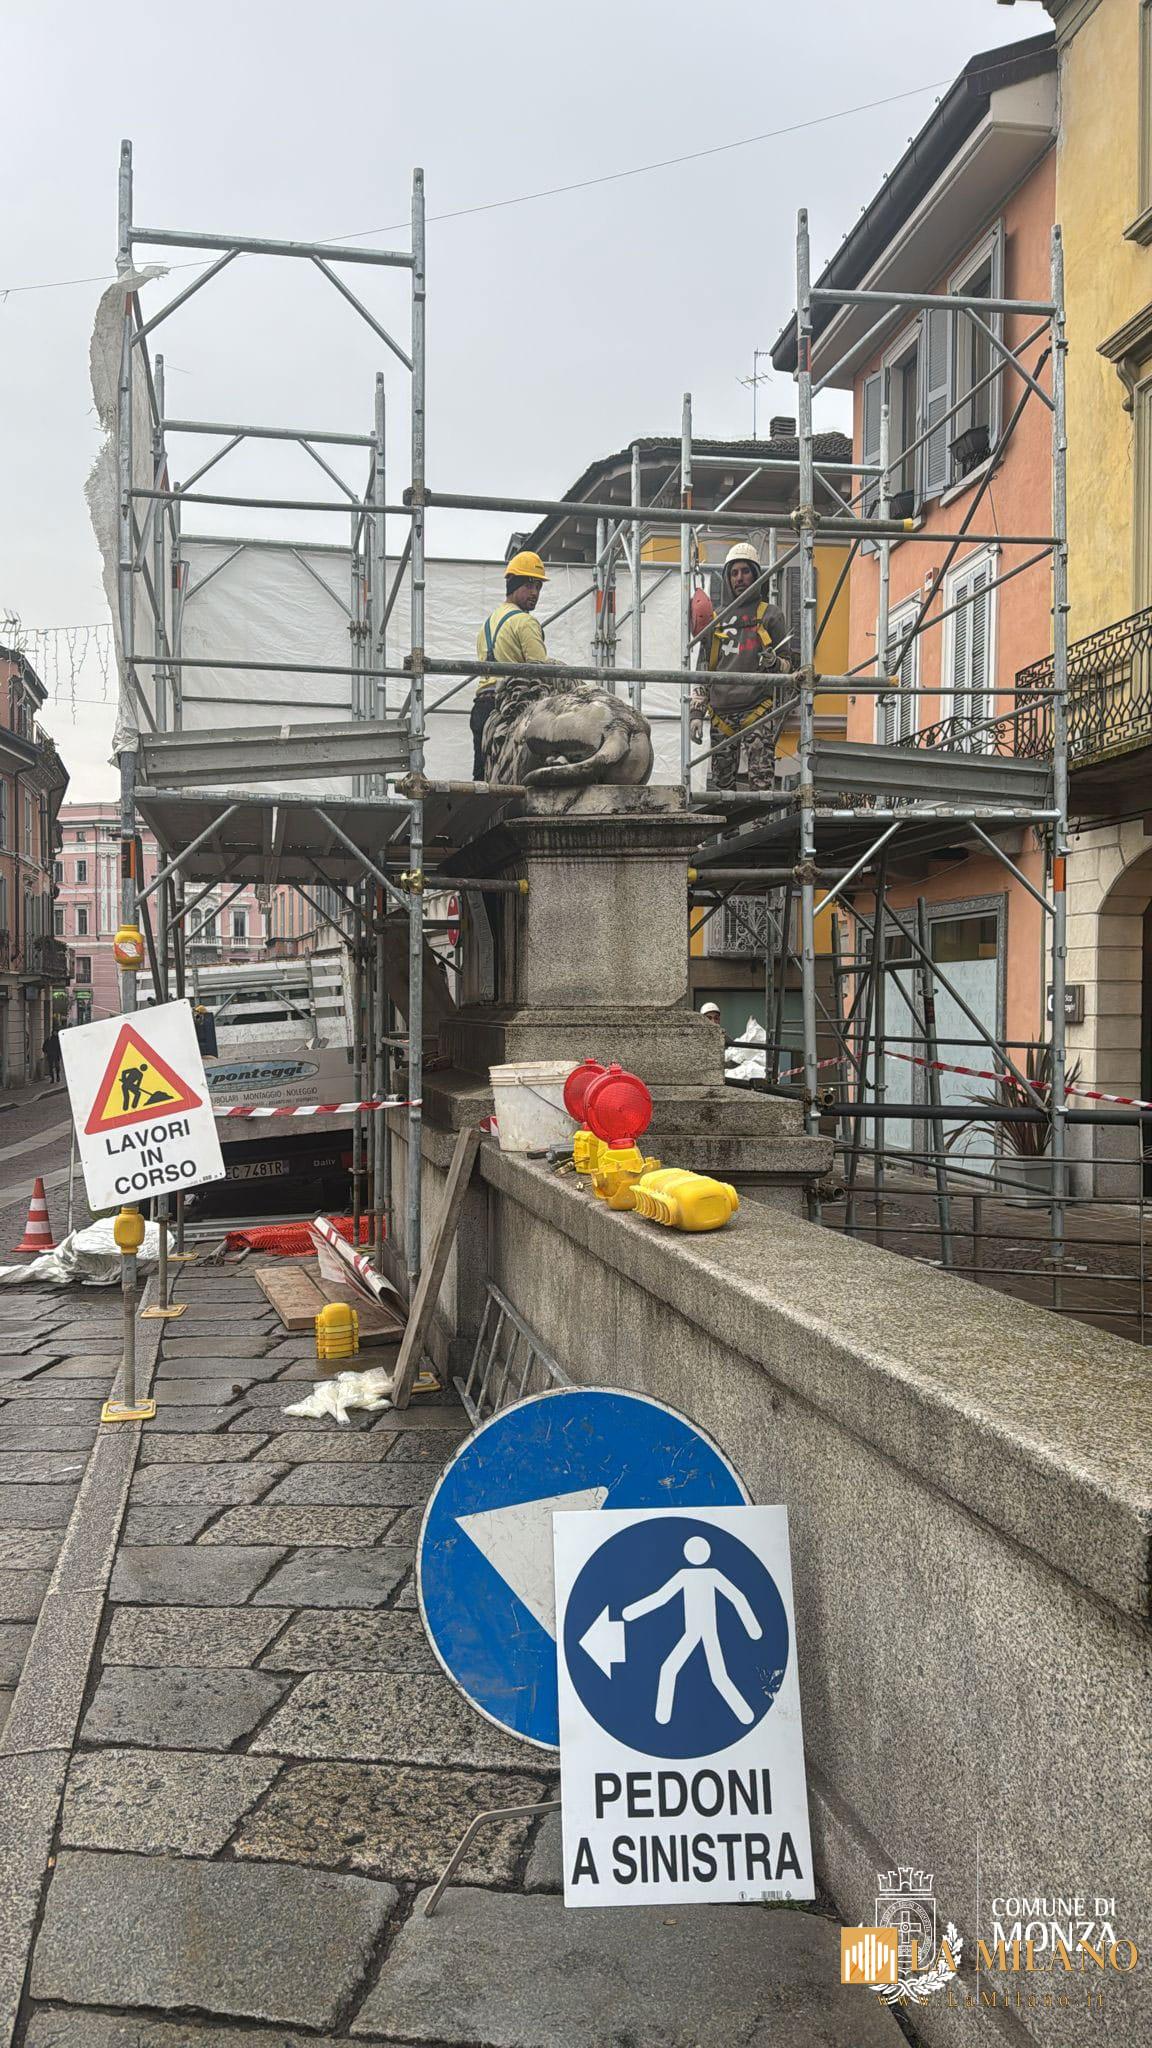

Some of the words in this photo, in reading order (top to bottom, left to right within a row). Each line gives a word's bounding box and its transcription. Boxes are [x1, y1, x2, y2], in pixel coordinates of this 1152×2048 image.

[212, 1062, 304, 1084] ponteggi
[243, 1091, 282, 1101] MONTAGGIO
[286, 1087, 318, 1097] NOLEGGIO
[105, 1118, 190, 1155] LAVORI
[140, 1146, 163, 1167] IN
[114, 1160, 197, 1195] CORSO
[594, 1768, 772, 1819] PEDONI
[571, 1837, 600, 1885] A
[611, 1832, 804, 1885] SINISTRA
